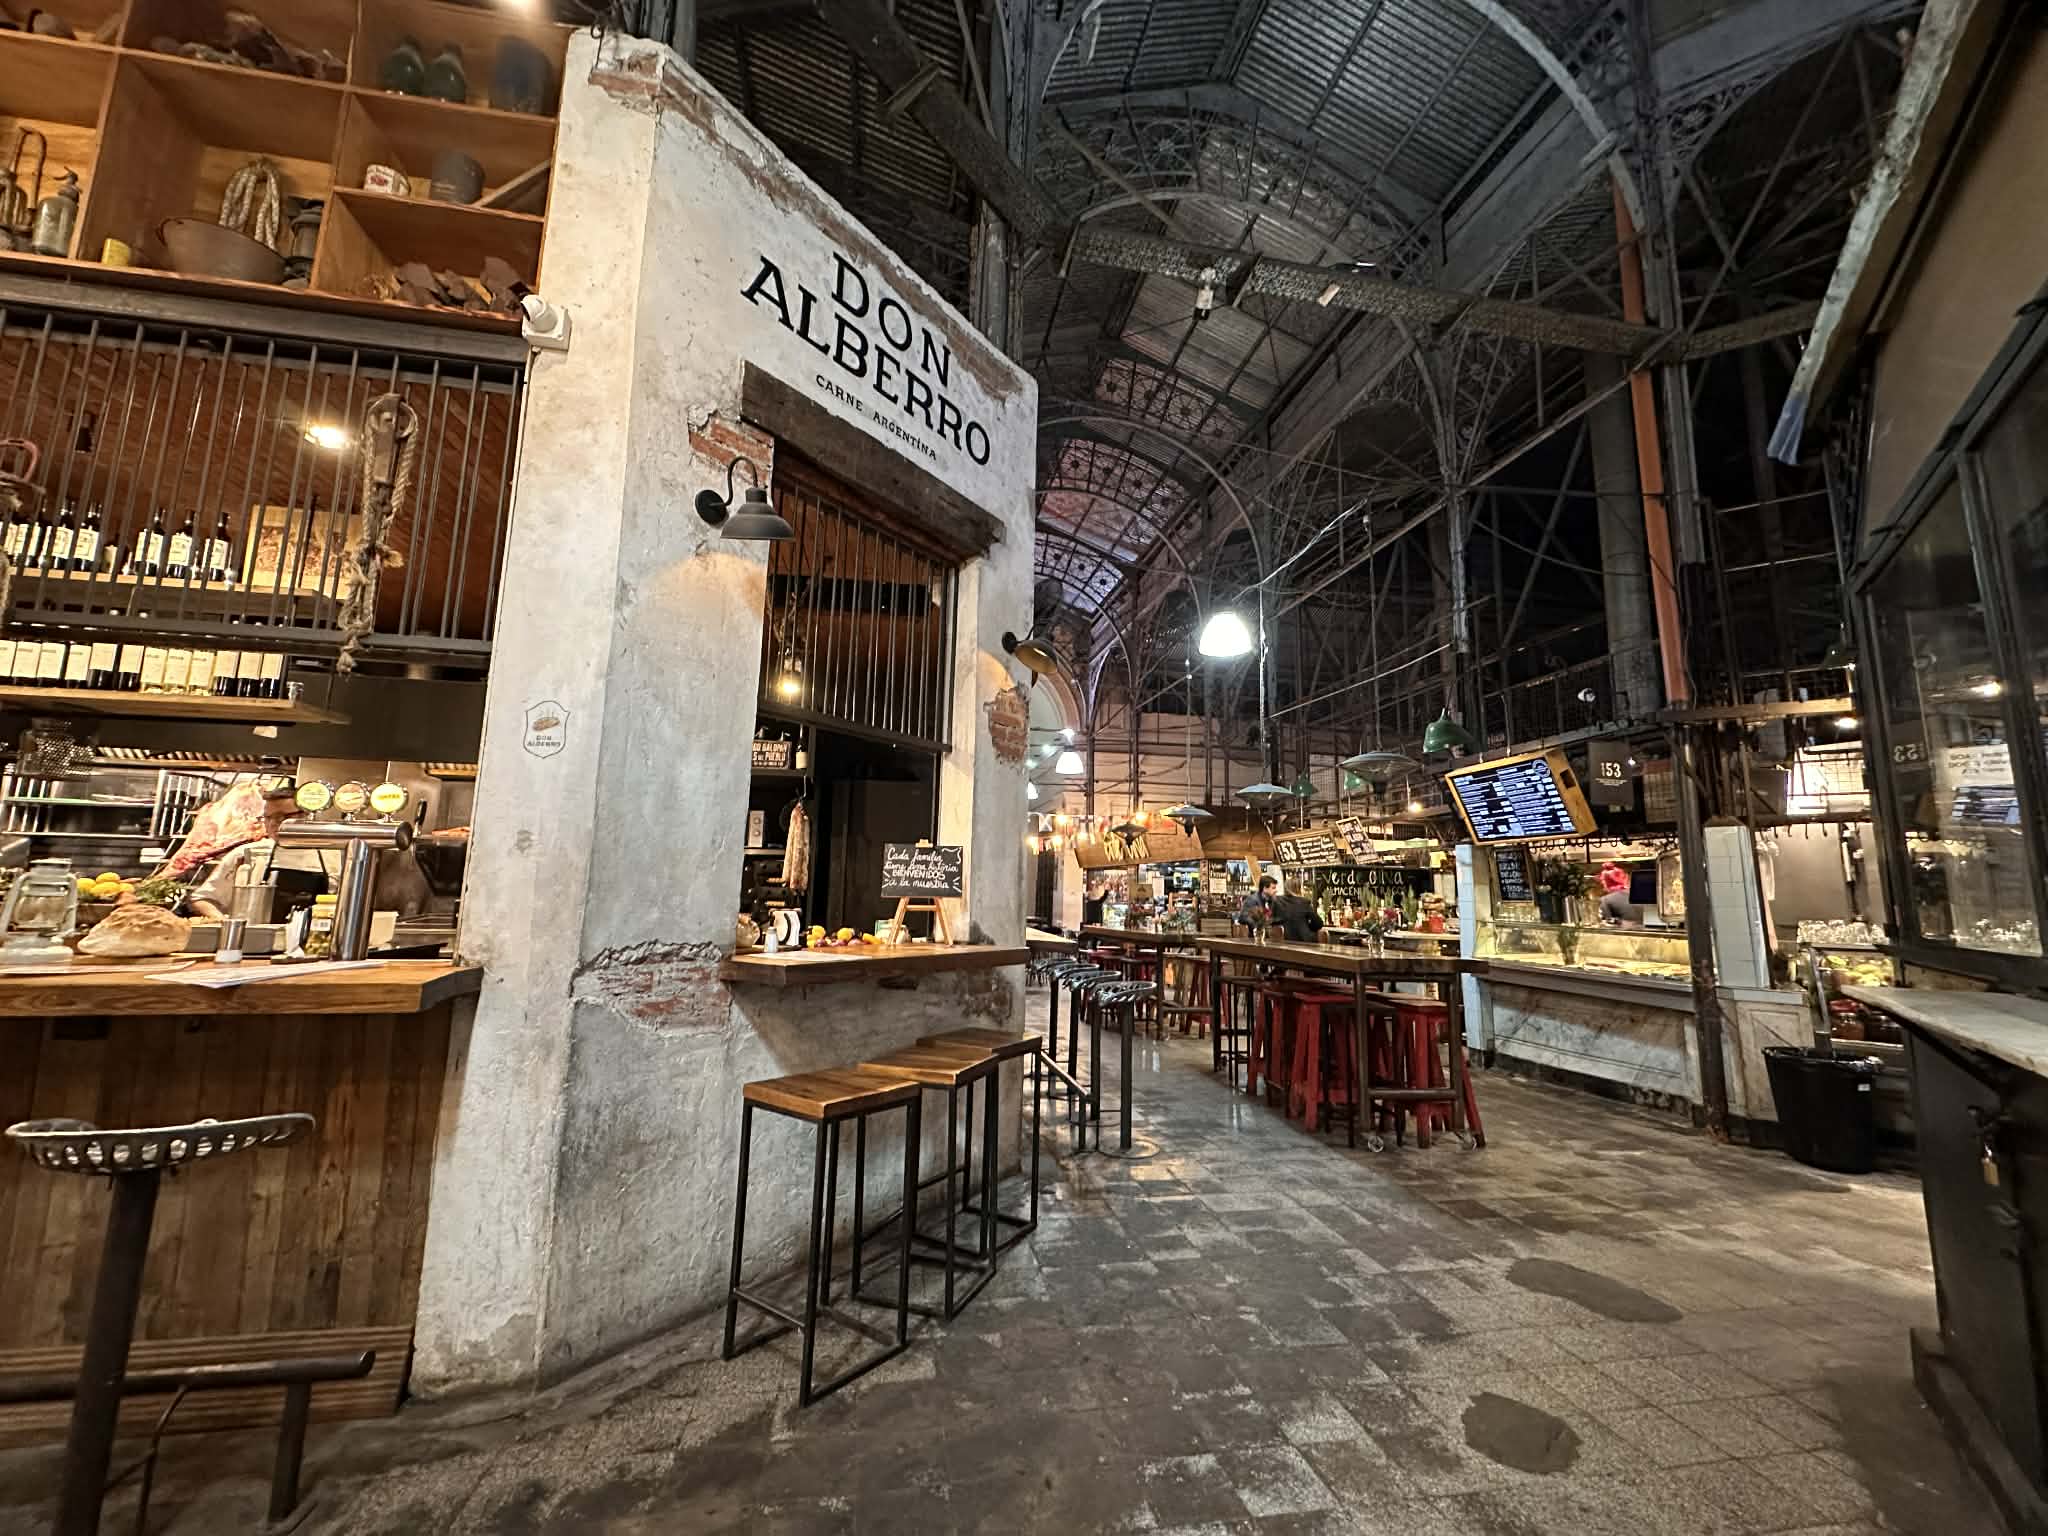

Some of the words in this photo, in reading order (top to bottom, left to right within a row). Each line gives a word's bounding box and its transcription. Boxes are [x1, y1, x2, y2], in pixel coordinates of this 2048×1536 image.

[832, 251, 952, 387] DON
[740, 256, 990, 465] ALBERRO
[816, 374, 864, 411] CARNE
[873, 410, 937, 460] ARGENTINA
[1600, 761, 1622, 778] 153
[887, 847, 910, 861] Cada
[892, 869, 946, 880] BIENVENIDOS
